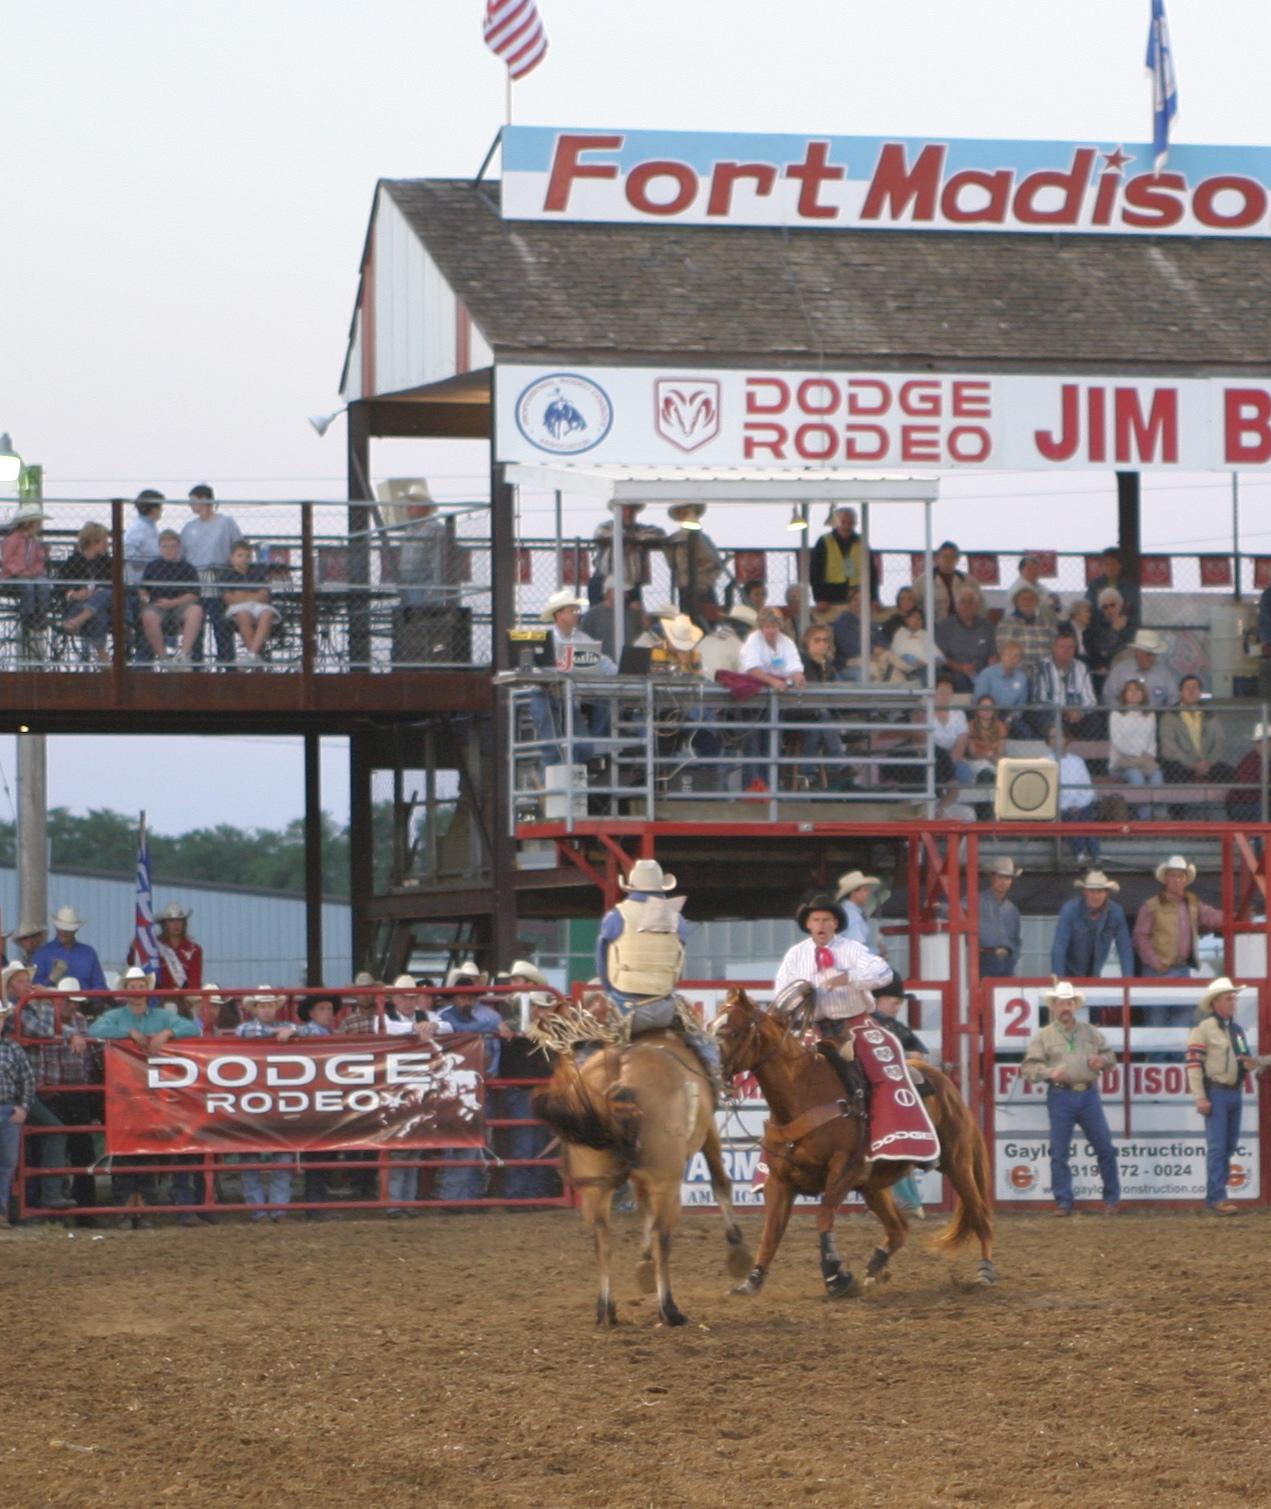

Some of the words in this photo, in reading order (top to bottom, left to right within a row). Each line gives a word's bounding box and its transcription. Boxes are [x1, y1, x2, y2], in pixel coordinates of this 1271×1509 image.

[544, 135, 843, 218] Fort
[745, 377, 992, 419] DODGE
[743, 422, 992, 463] RODEO
[1034, 384, 1178, 464] JIM
[1003, 997, 1032, 1038] 2
[147, 1052, 433, 1089] DODGE
[206, 1090, 387, 1114] RODEO
[1004, 1143, 1078, 1161] Gayld
[1084, 1143, 1206, 1158] Cstruction
[1120, 1164, 1139, 1177] 72
[1154, 1164, 1192, 1177] 0024
